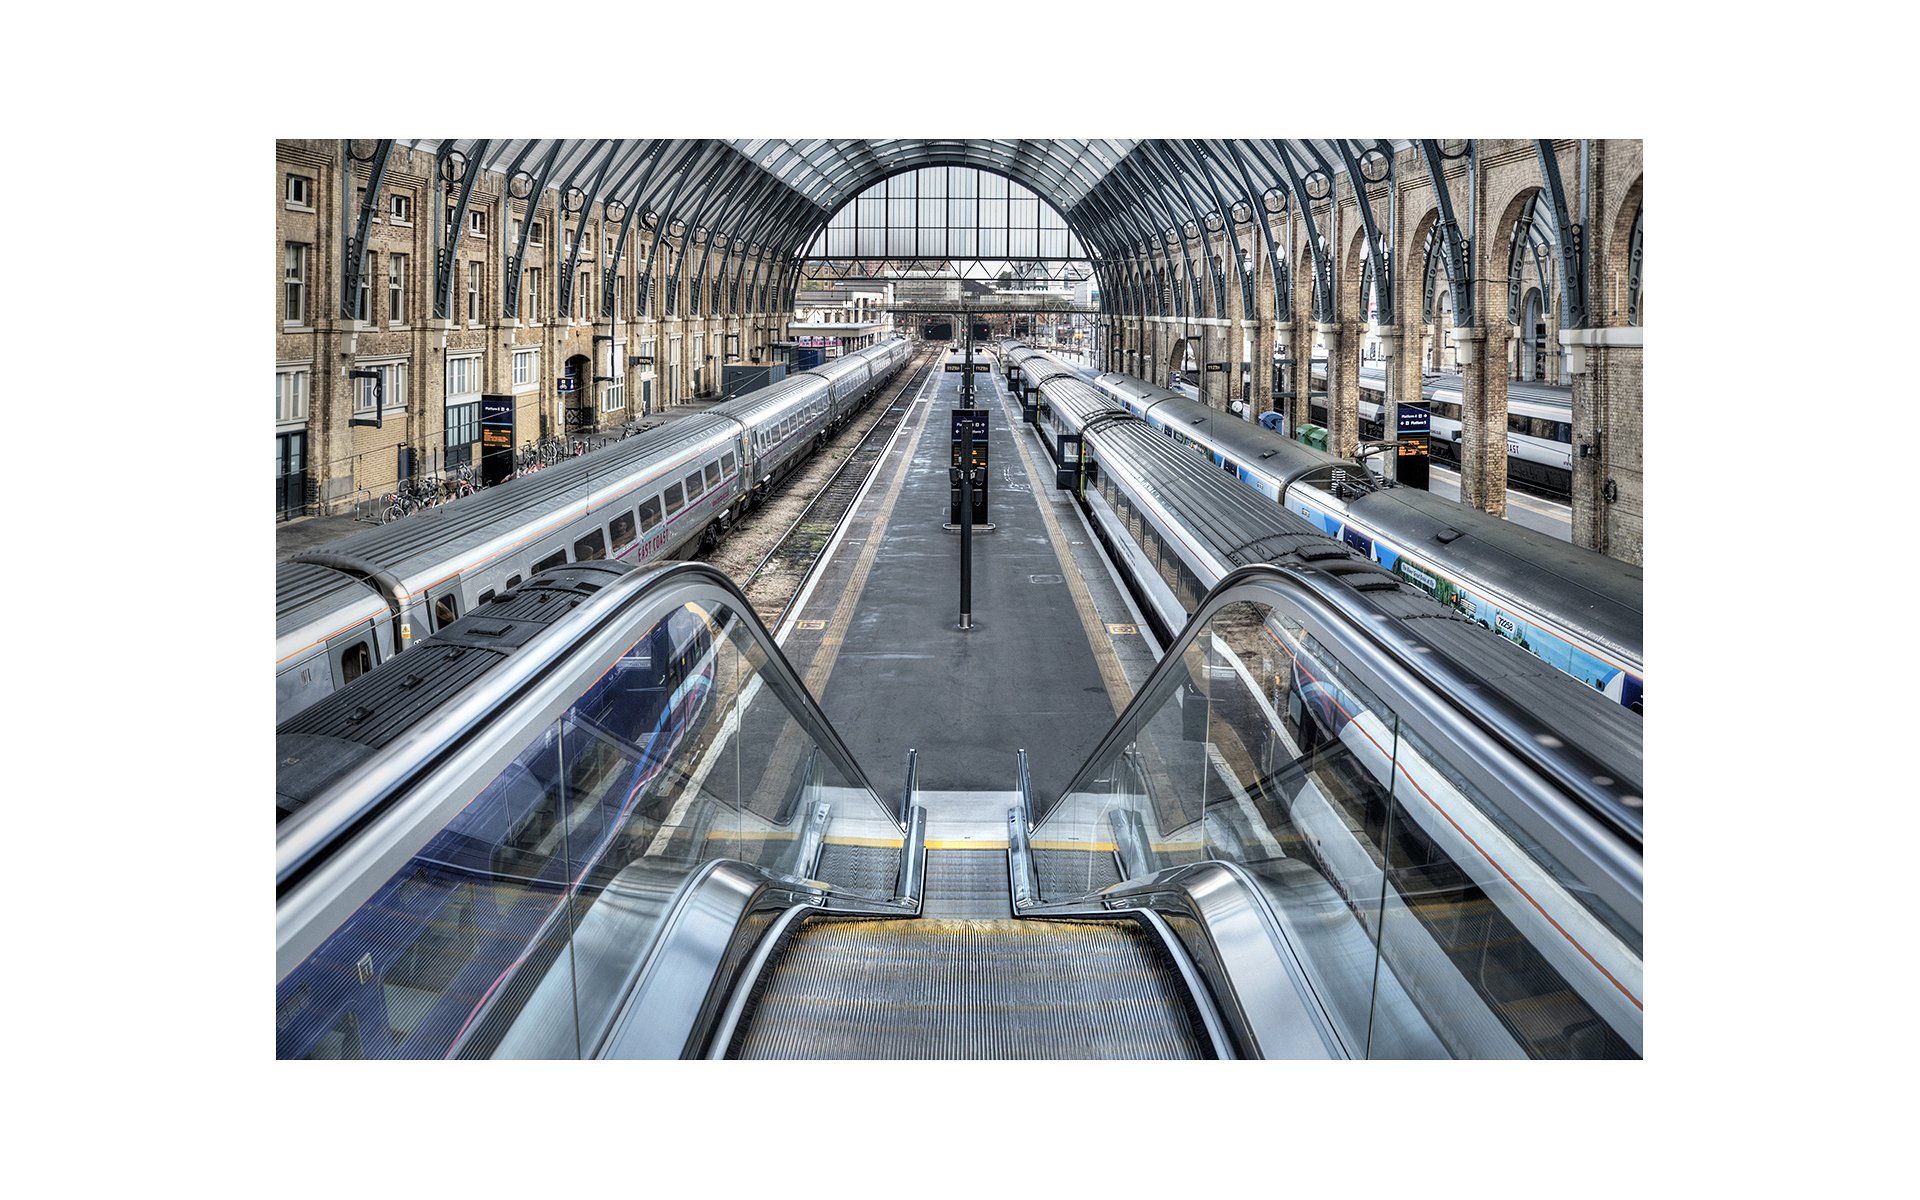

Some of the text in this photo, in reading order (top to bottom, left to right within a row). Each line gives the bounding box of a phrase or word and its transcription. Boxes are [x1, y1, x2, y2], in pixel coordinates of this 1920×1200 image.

[1507, 443, 1519, 454] AST
[637, 528, 669, 562] EAST COAST
